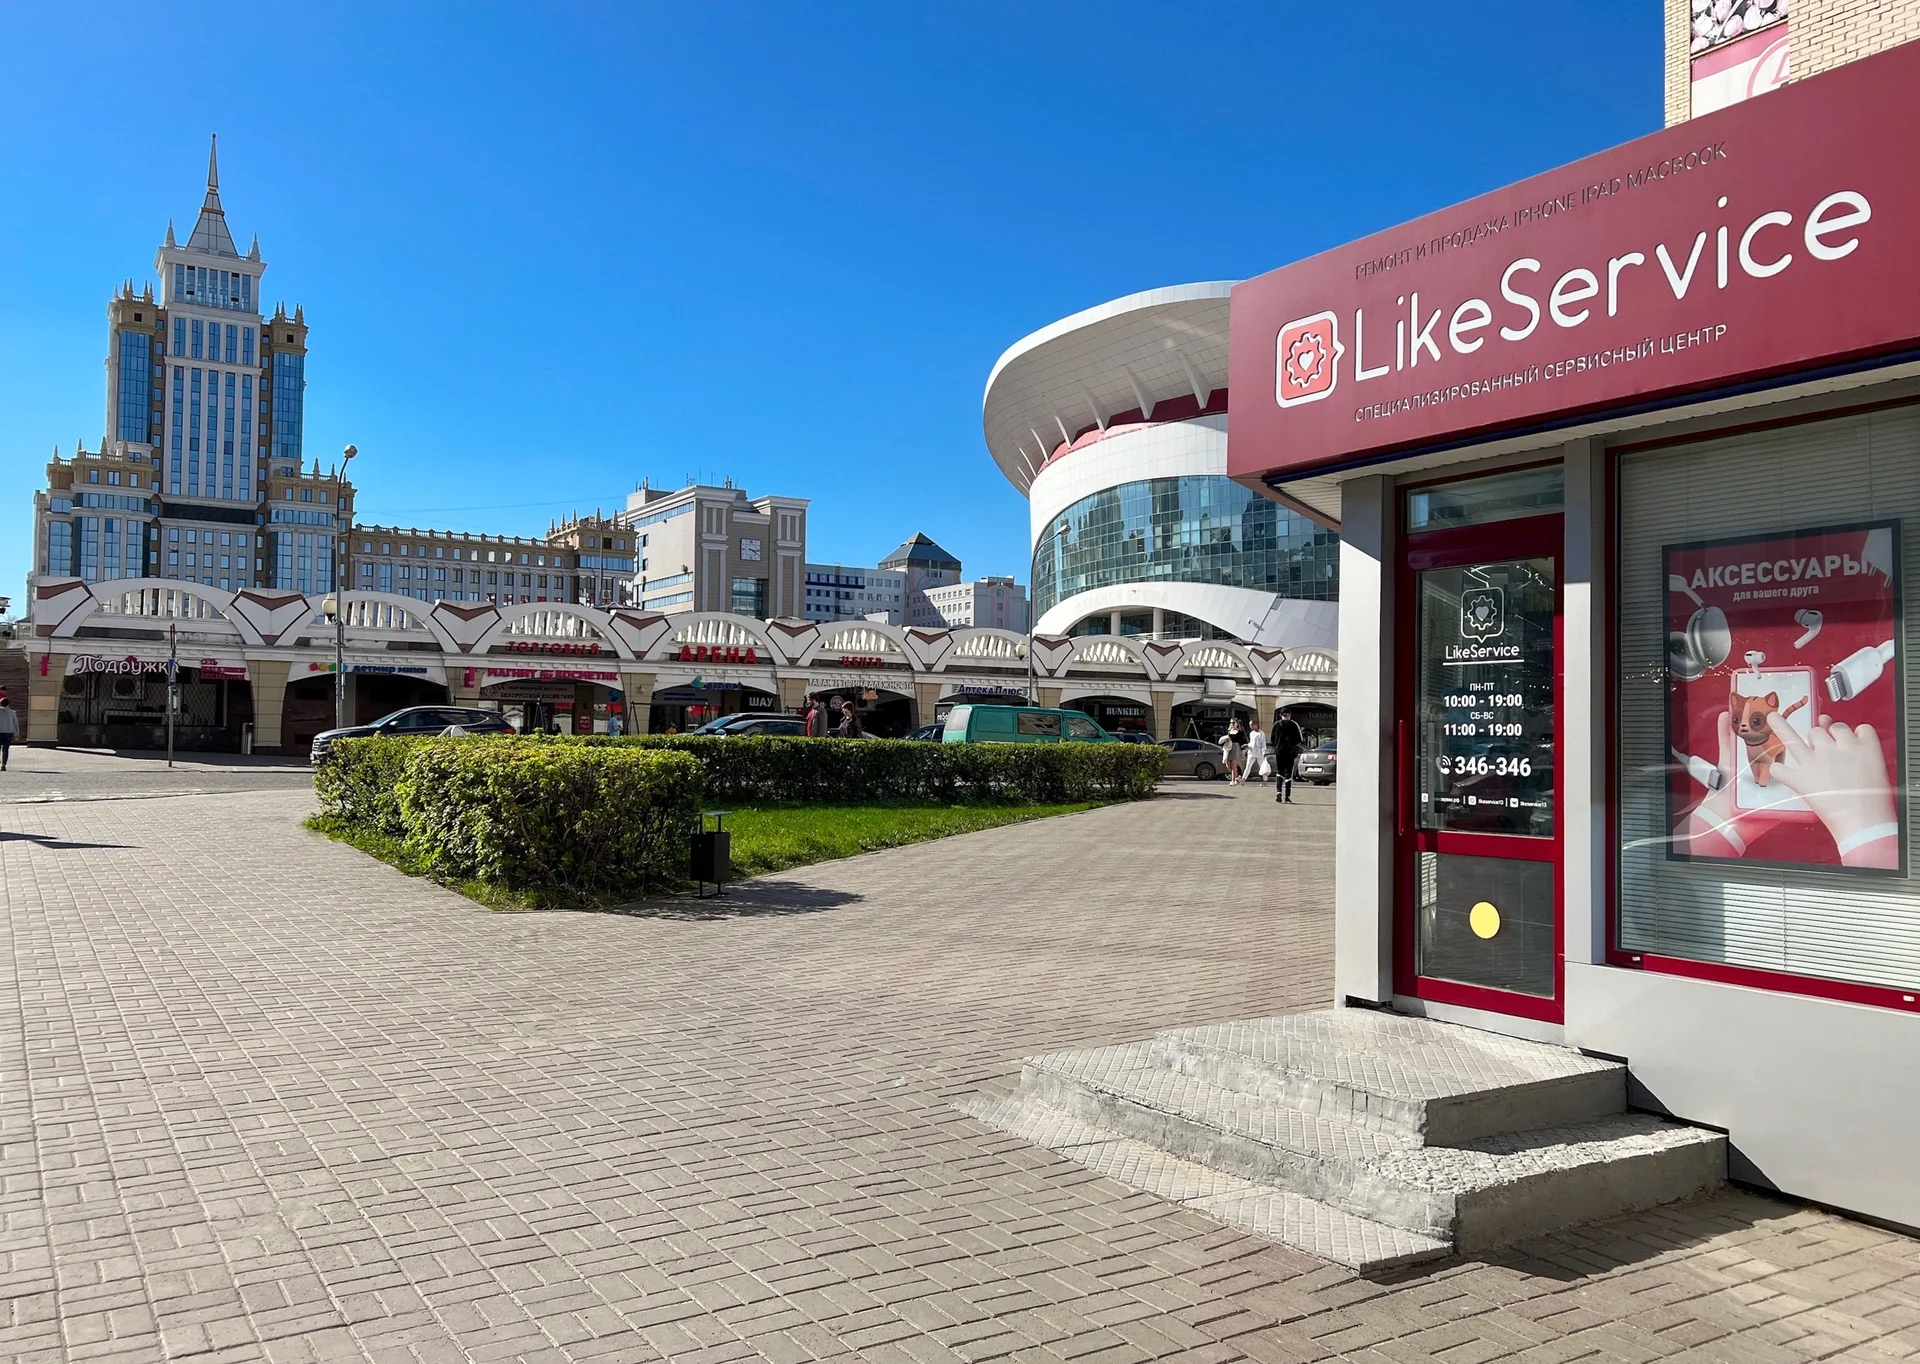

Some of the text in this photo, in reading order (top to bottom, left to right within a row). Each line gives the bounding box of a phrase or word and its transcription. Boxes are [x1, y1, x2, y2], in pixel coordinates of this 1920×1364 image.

[1356, 141, 1727, 279] РЕМОНТ И ПРОДАЖА IPHONE IPAD MACBOOK
[1354, 190, 1872, 383] LikeService
[1355, 323, 1728, 422] СПЕЦИАЛИЗИРОВАННЫЙ СЕРВИСНЫЙ ЦЕНТР
[1691, 554, 1869, 589] АКСЕССУАРЫ
[1733, 585, 1819, 602] для вашего друга
[507, 641, 602, 655] ТОРГОВЫЙ
[679, 645, 759, 664] АРЕНА
[1445, 642, 1520, 659] LikeService
[840, 656, 884, 667] ЦЕНТР
[1469, 682, 1495, 691] ПН-ПТ
[1444, 695, 1476, 707] 10:00
[1488, 694, 1523, 707] 19:00
[1106, 707, 1139, 716] BUNKER
[1470, 711, 1494, 719] СБ-ВС
[1444, 723, 1476, 736] 11:00
[1488, 723, 1522, 736] 19:00
[1454, 756, 1531, 777] 346-346
